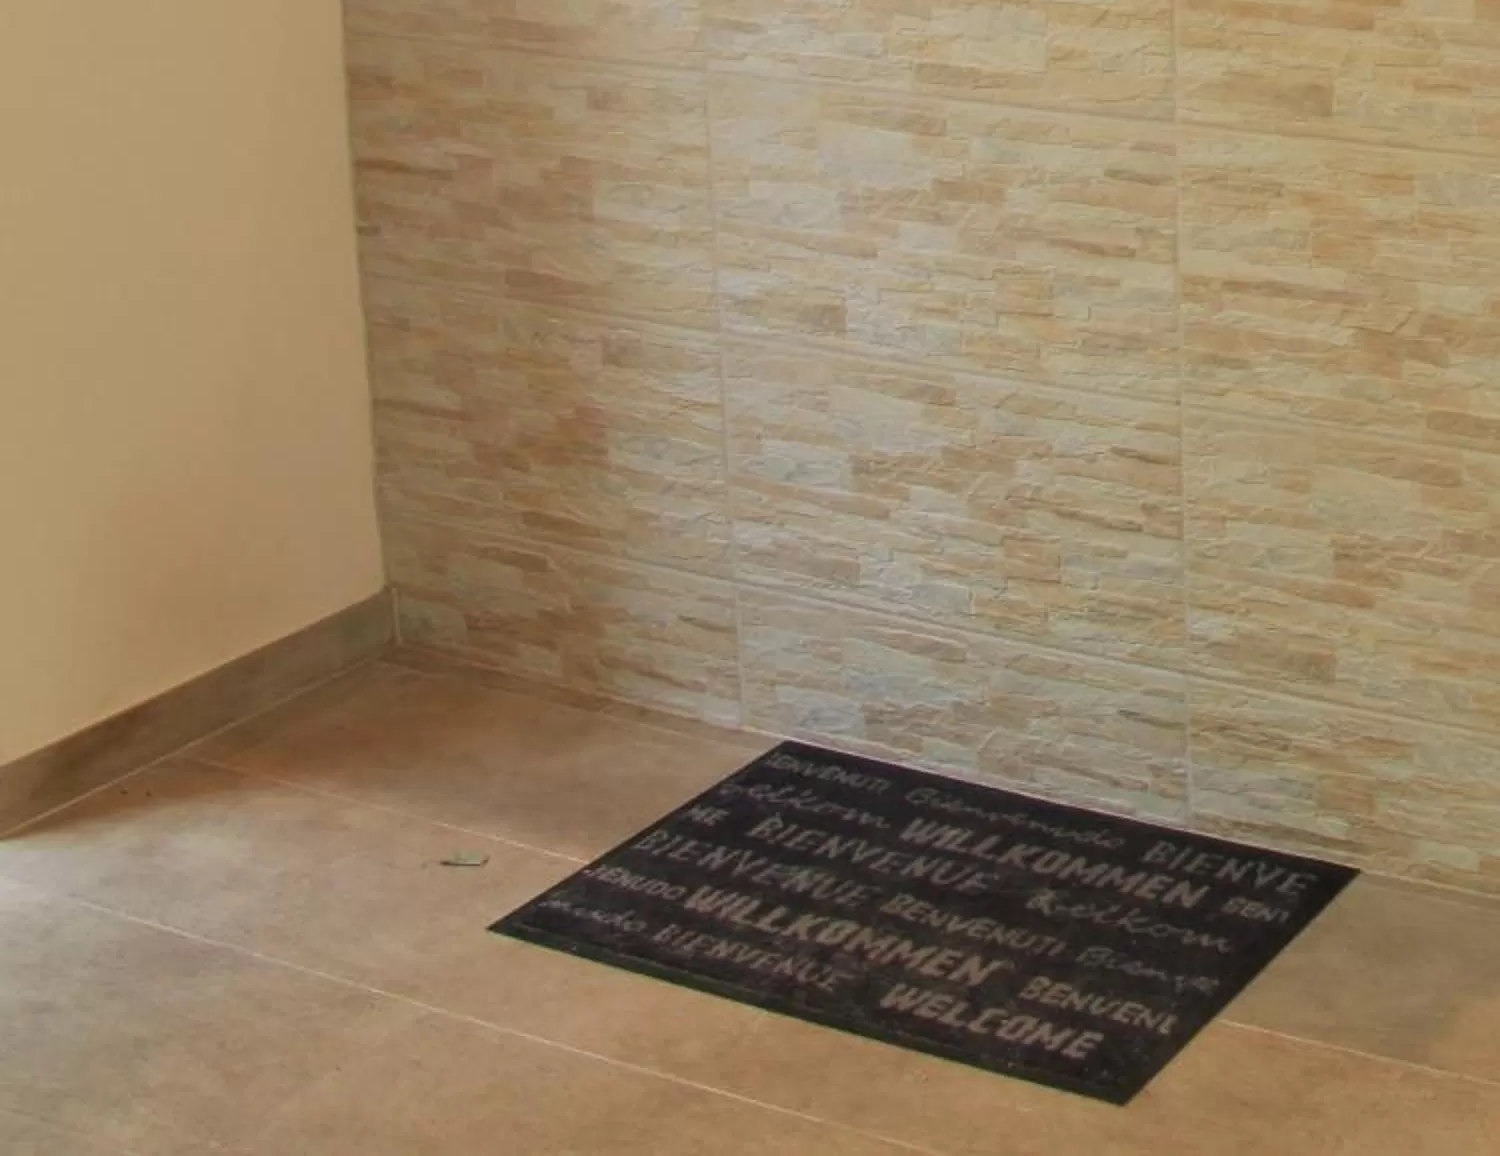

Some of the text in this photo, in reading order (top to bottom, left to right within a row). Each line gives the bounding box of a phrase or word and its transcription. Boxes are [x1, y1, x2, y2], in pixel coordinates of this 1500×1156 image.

[634, 830, 881, 907] BIENVENUE
[880, 892, 1068, 957] BENVENUTI
[746, 815, 998, 891] BIENVENUE
[900, 817, 1210, 908] WILLKOMMEN
[684, 885, 1006, 986] WILLKOMMEN
[652, 924, 856, 992] BIENVENUE
[880, 983, 1104, 1061] WELCOME
